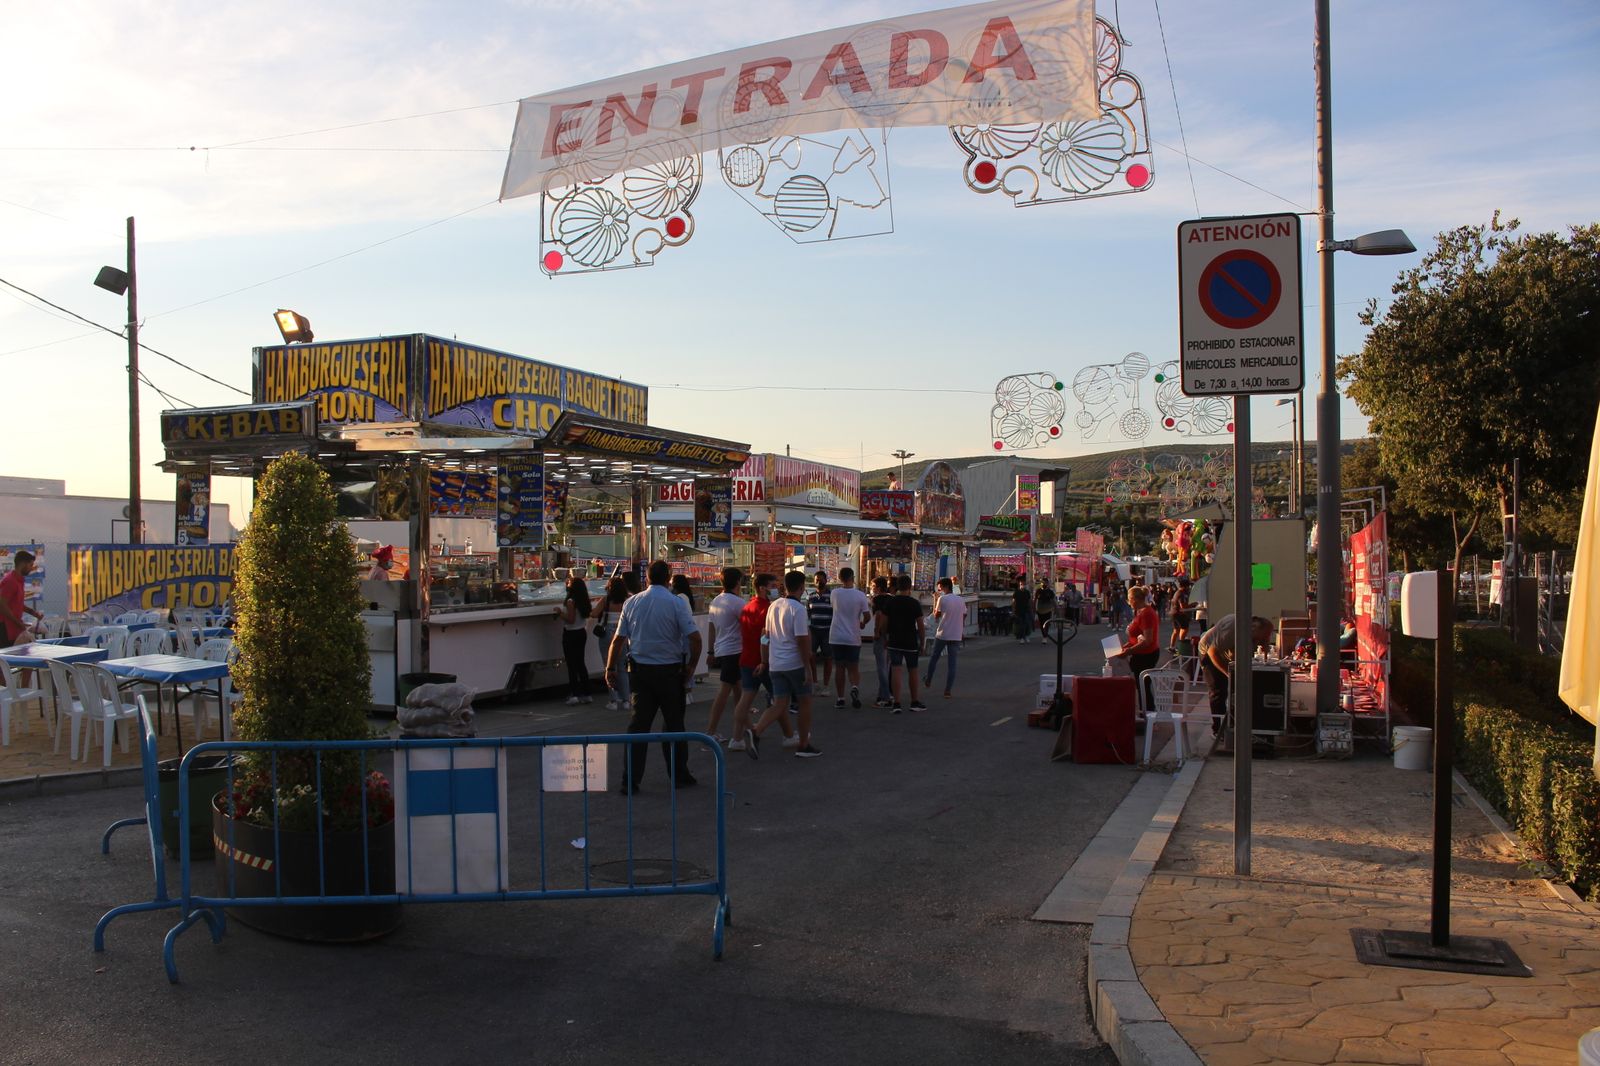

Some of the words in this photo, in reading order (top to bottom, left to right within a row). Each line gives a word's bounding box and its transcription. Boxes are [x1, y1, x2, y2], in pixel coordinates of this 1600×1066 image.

[540, 16, 1038, 160] ENTRADA
[1188, 219, 1291, 243] ATENCIÓN
[1187, 339, 1236, 351] PROHIBIDO
[1240, 336, 1296, 348] ESTACIONAR
[1185, 357, 1236, 370] MIÉRCOLES
[1240, 356, 1298, 368] MERCADILLO
[266, 341, 409, 417] HAMBURGUESERIA
[429, 342, 562, 418] HAMBURGUESERIA
[566, 371, 646, 426] BAGUETTERIA
[1194, 380, 1206, 389] De
[1210, 379, 1227, 390] 7,30
[1241, 378, 1262, 388] 14,00
[1266, 377, 1290, 386] horas
[308, 391, 376, 422] HONI
[493, 398, 566, 433] CHO
[188, 410, 302, 440] KEBAB
[583, 429, 663, 455] HAMBURGUESAS
[666, 443, 727, 464] BAGUETTES
[179, 531, 186, 544] 5
[700, 535, 707, 546] 5
[70, 549, 216, 613] HAMBURGUESERIA
